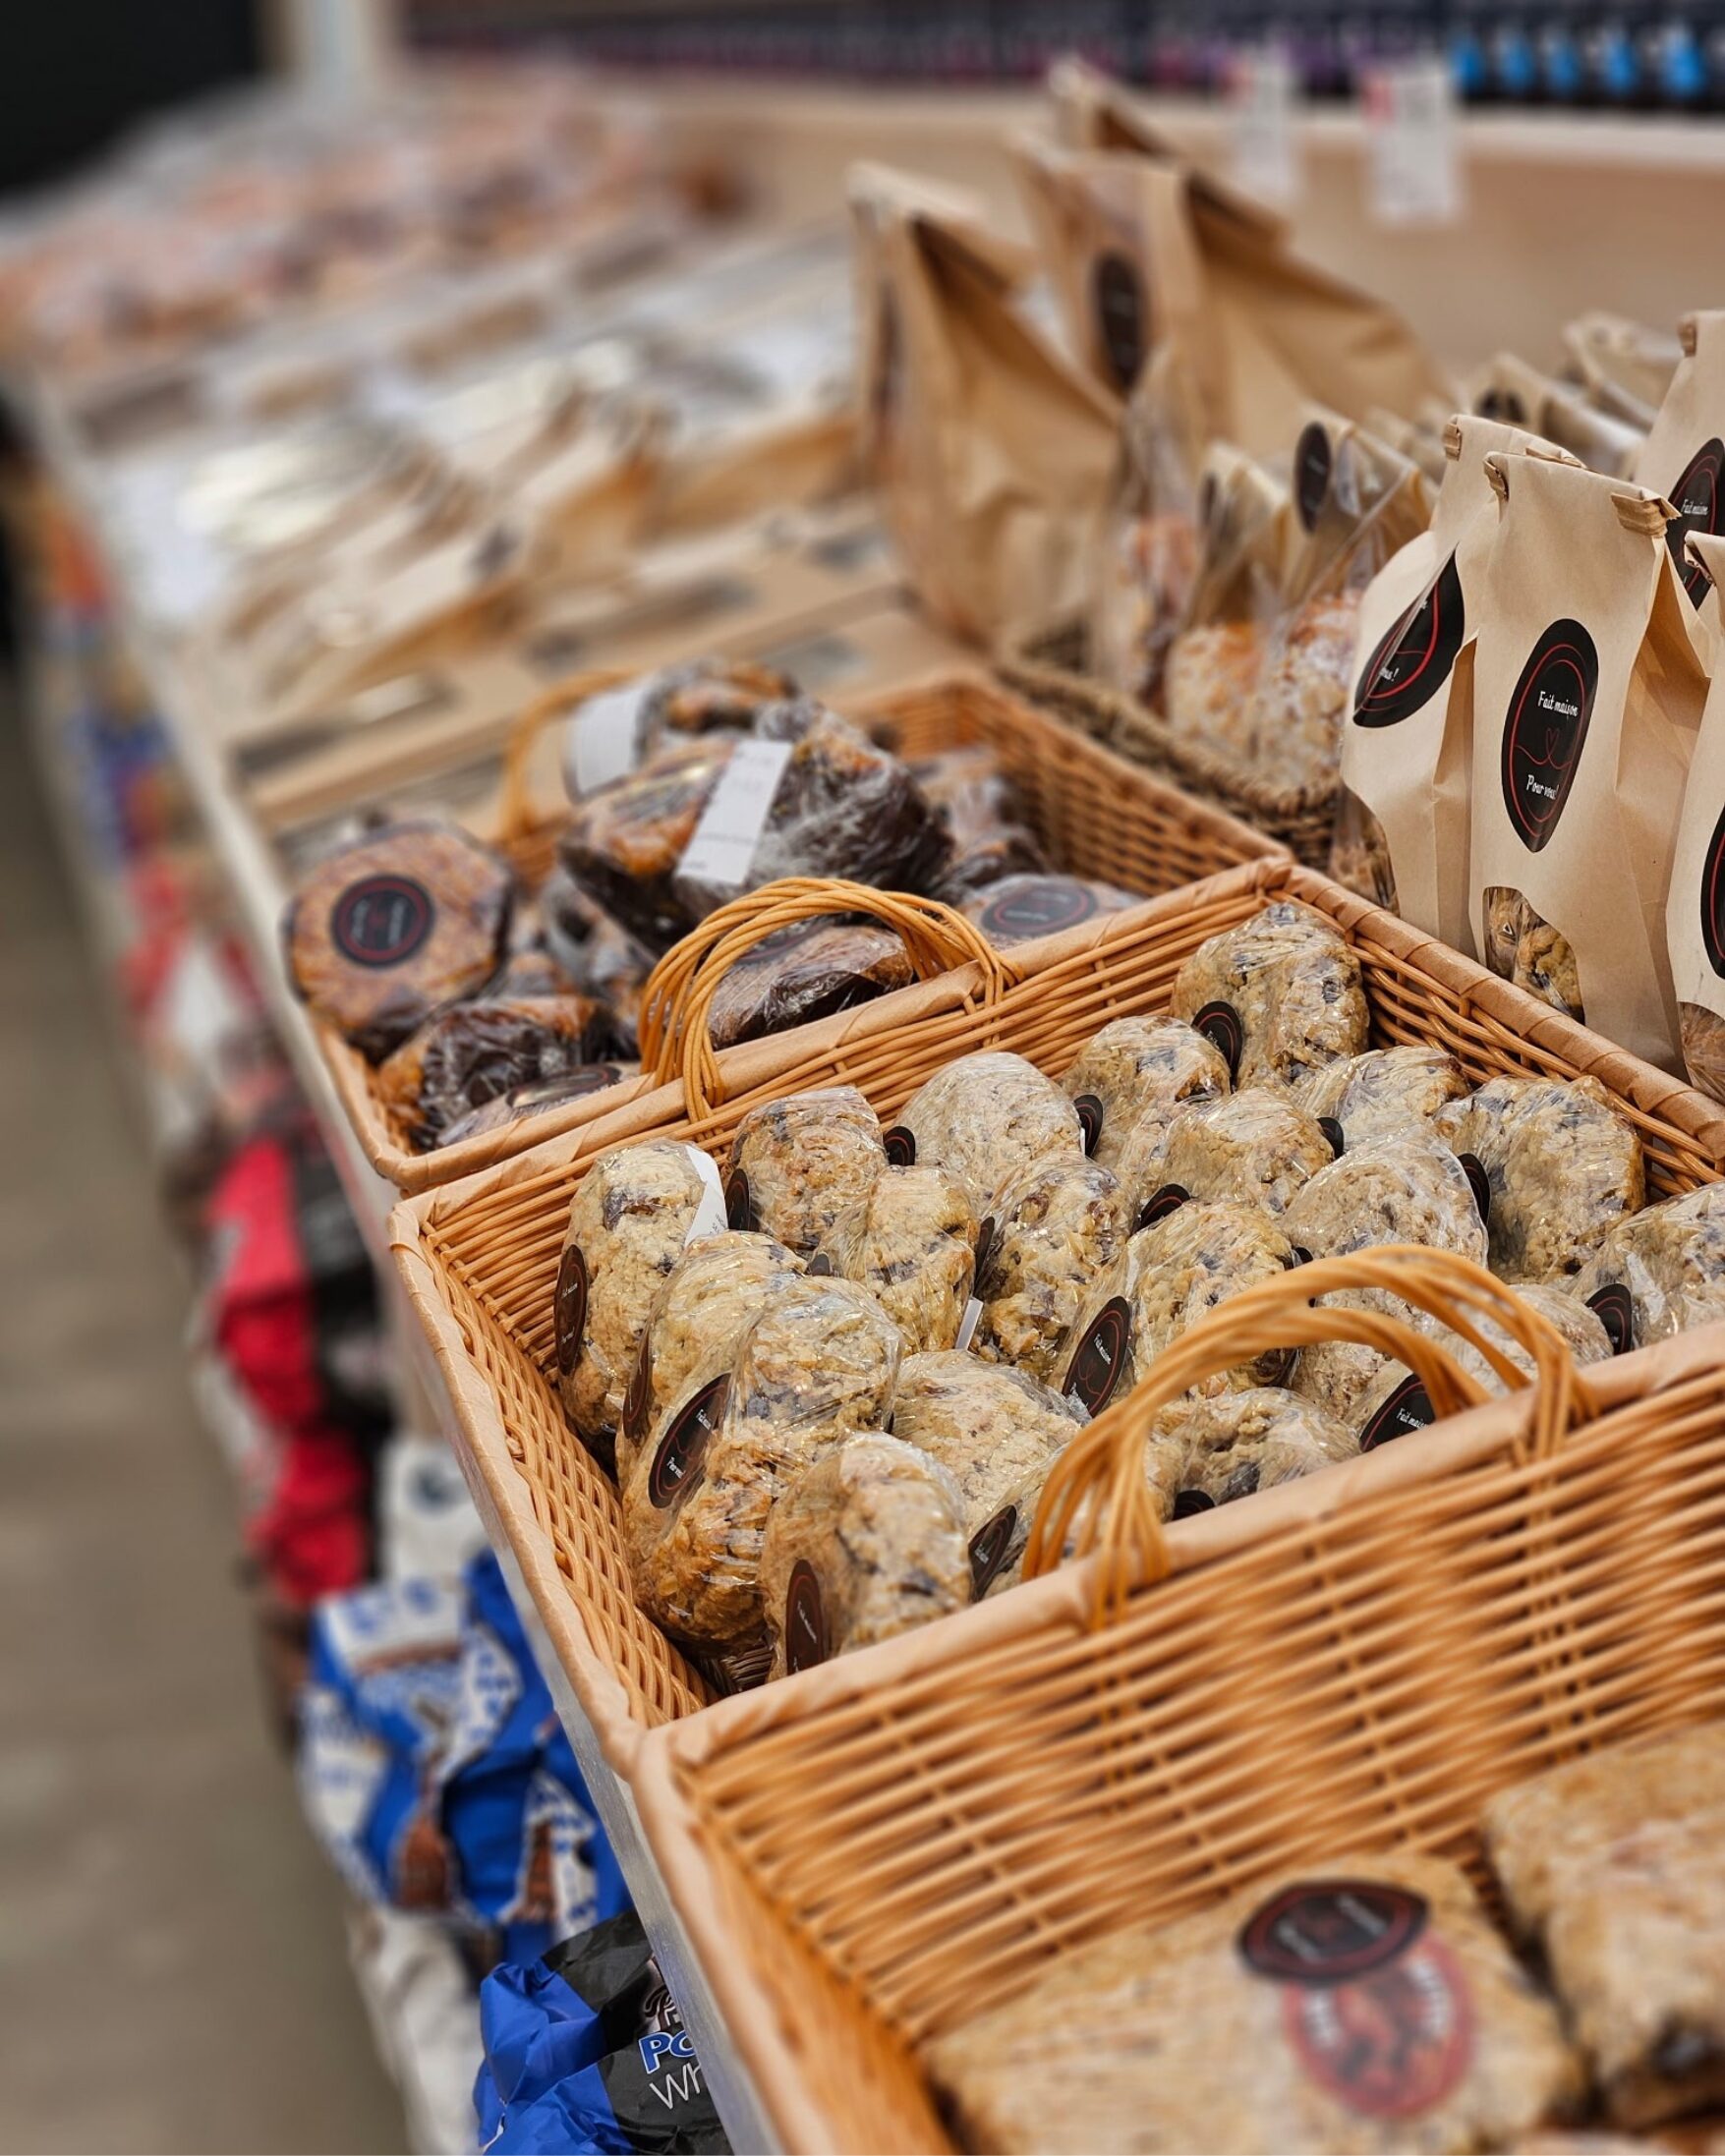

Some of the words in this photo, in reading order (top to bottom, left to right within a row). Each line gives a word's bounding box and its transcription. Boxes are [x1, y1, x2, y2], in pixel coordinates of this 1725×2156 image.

[1538, 690, 1554, 710] Fait
[1553, 699, 1579, 717] maison
[1525, 773, 1544, 795] Pour
[1396, 1407, 1411, 1423] Fait
